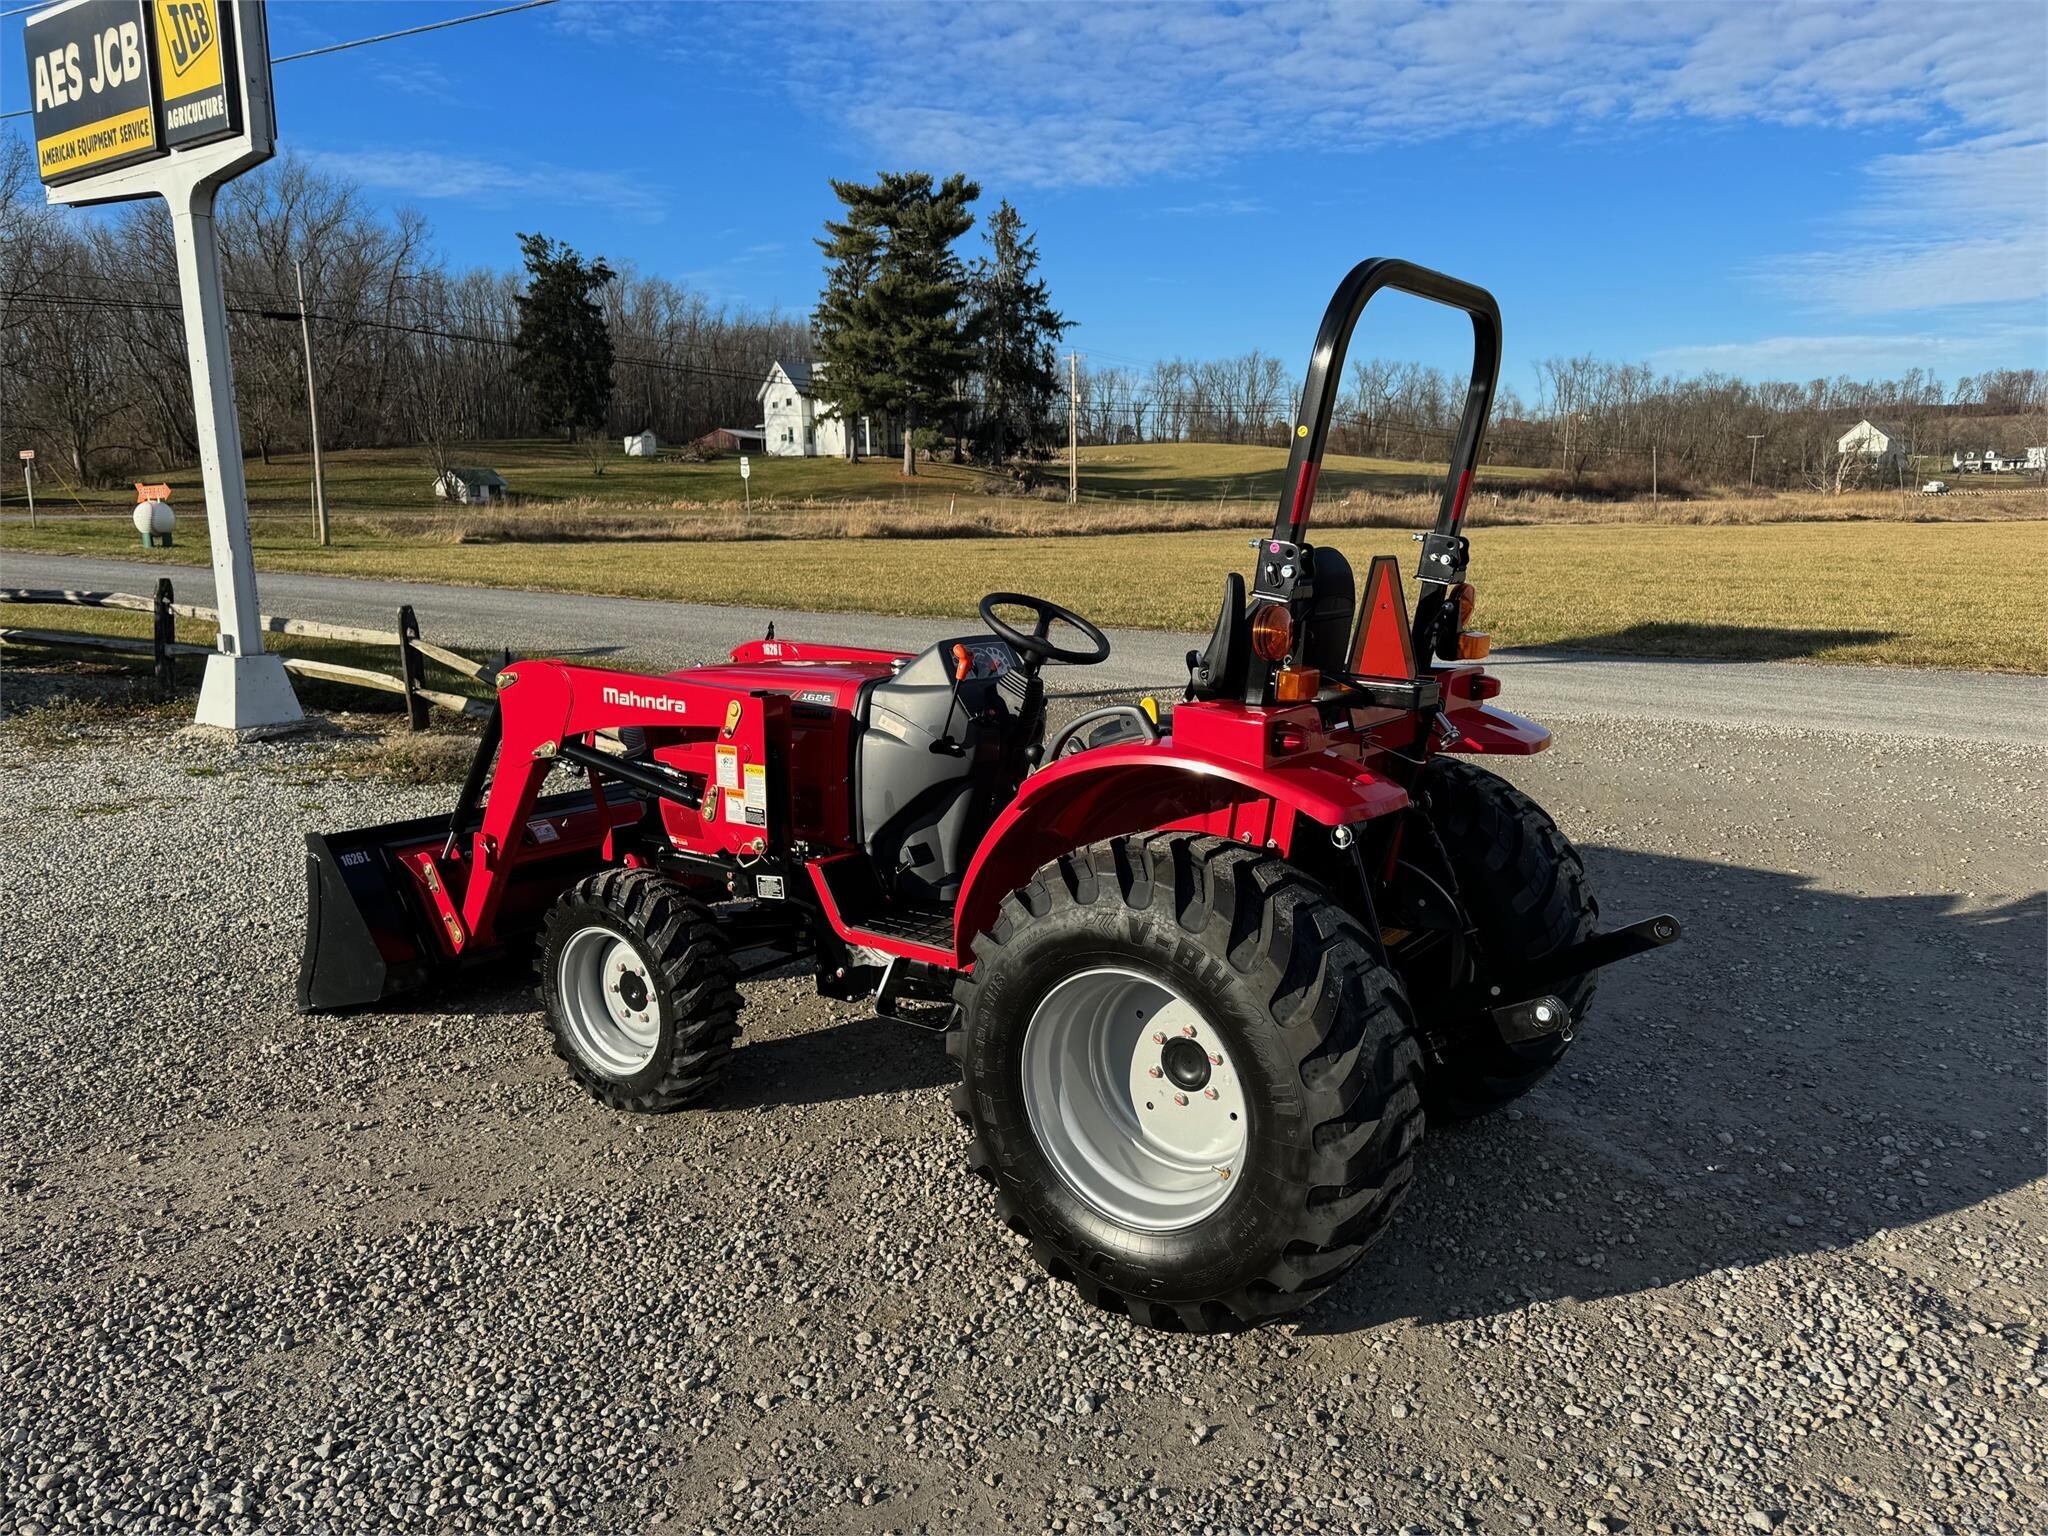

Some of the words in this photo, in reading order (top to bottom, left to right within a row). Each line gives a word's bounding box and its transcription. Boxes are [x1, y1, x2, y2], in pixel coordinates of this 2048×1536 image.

[167, 2, 210, 66] JCB
[35, 42, 83, 113] AES
[90, 21, 141, 94] JCB
[167, 95, 224, 130] AGRICULTURE
[42, 140, 76, 167] AMERICAN
[77, 128, 117, 157] EQUIPMENT
[119, 119, 150, 143] SERVICE
[762, 643, 778, 656] 1626
[602, 687, 686, 713] Mahindra
[801, 693, 831, 702] 1626
[340, 852, 364, 866] 1626
[363, 851, 371, 862] L
[1129, 916, 1235, 997] V-BH
